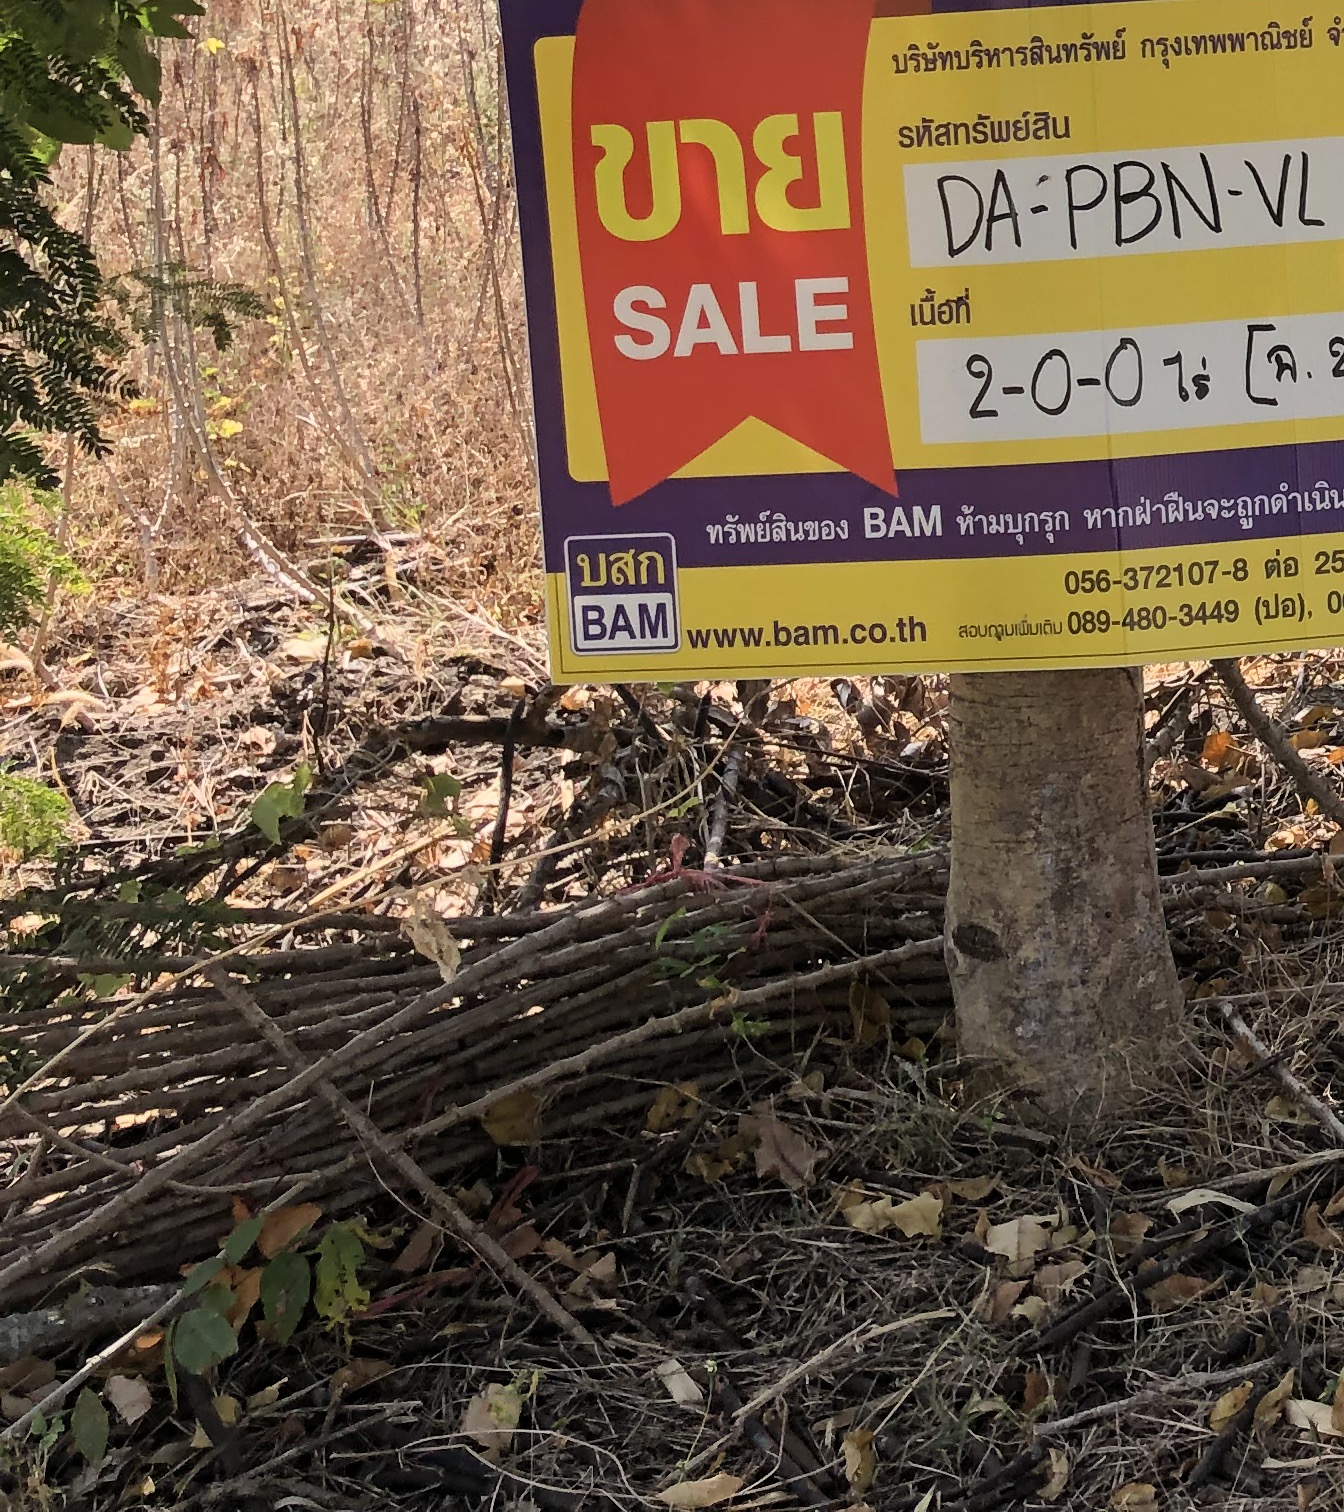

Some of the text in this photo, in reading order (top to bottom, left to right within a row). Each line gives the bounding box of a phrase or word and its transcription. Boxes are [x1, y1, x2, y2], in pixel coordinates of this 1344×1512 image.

[891, 27, 1127, 74] บริษัทบริหารสินทรัพย์
[1140, 15, 1313, 70] กรุงเทพพาณิชย์
[897, 110, 1072, 149] รหัสทรัพย์สิน
[590, 111, 852, 242] ขาย
[613, 276, 854, 361] SALE
[909, 287, 971, 326] เนื้อที่
[965, 337, 1143, 419] 2-0-0
[705, 509, 849, 545] ทรัพย์สินของ
[863, 504, 944, 539] BAM
[955, 504, 1071, 546] ห้ามบุกรุก
[576, 548, 667, 587] บสก
[1064, 557, 1249, 595] 056-372107-8
[1263, 548, 1300, 580] ต่อ
[581, 602, 670, 642] BAM
[686, 615, 928, 649] www.bam.co.th
[1066, 598, 1241, 636] 089-480-3449
[1254, 592, 1314, 626] (ปอ),
